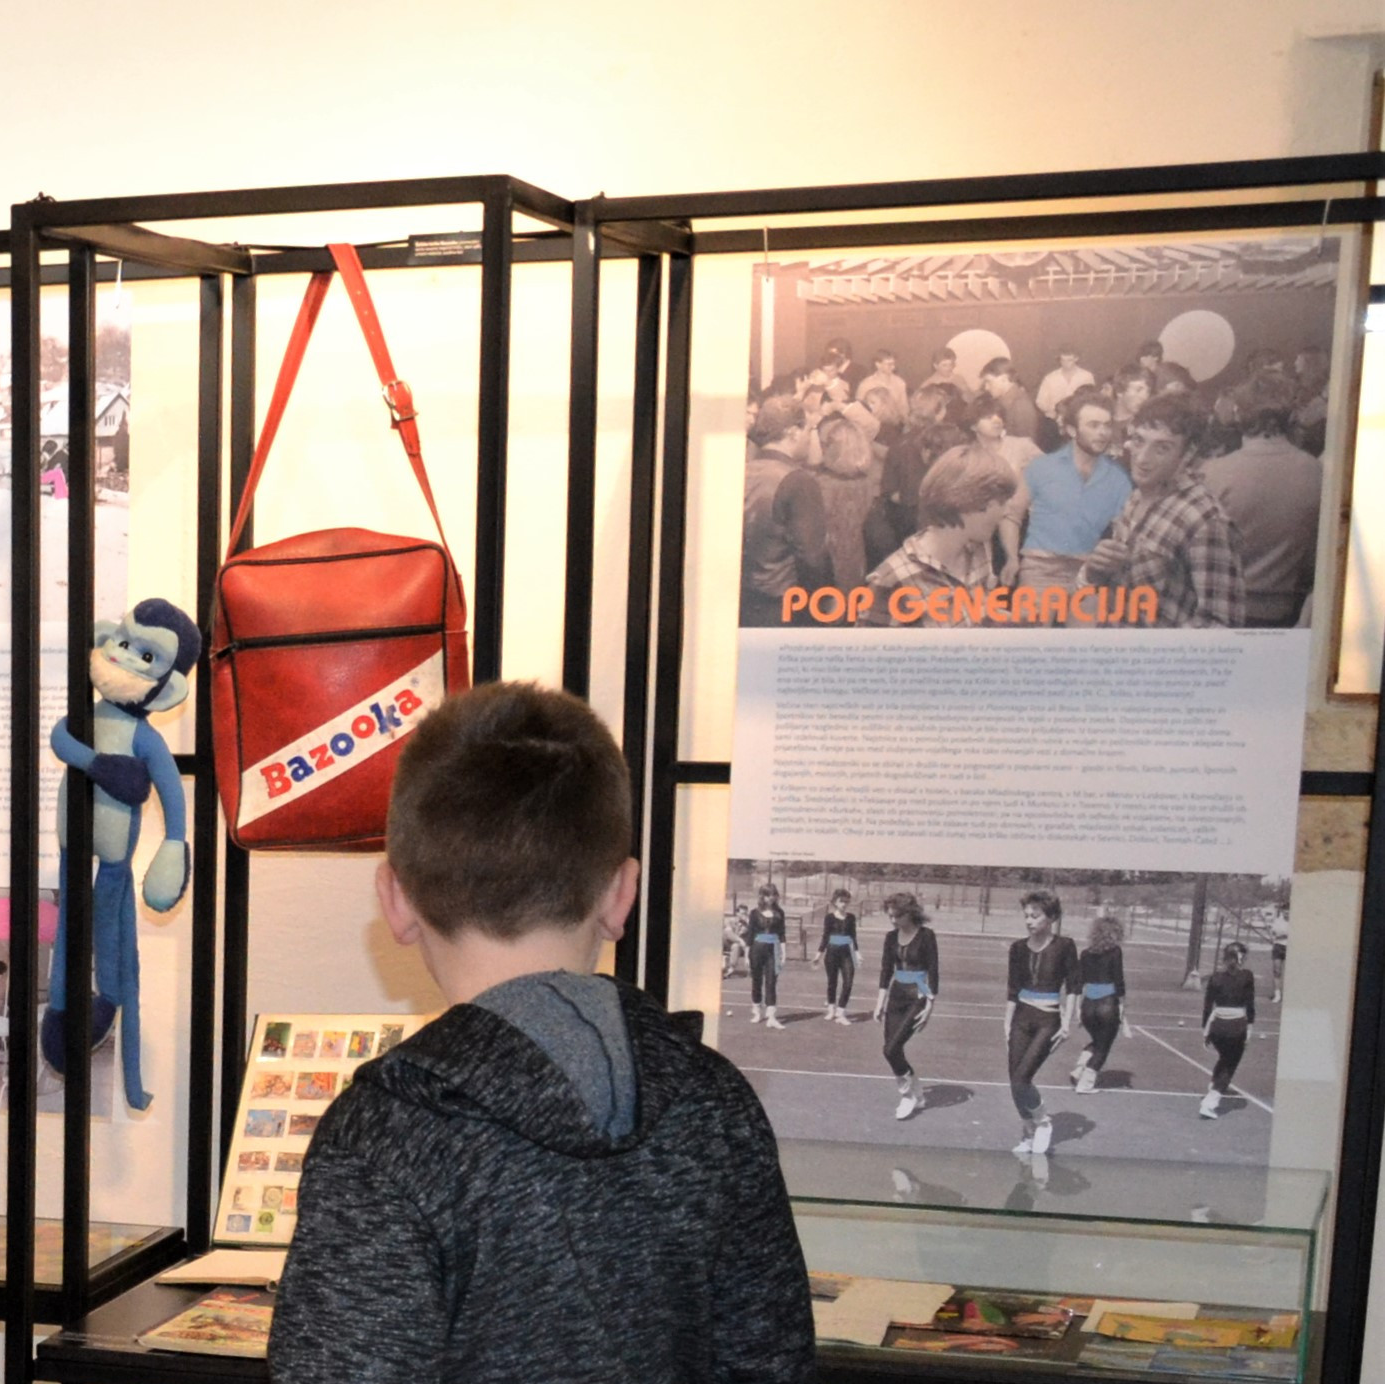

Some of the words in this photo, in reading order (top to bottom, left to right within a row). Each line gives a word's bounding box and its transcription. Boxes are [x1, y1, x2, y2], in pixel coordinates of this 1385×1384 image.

[781, 585, 875, 623] POP
[887, 585, 1160, 623] GENERACIJA
[259, 688, 423, 800] Bazooka
